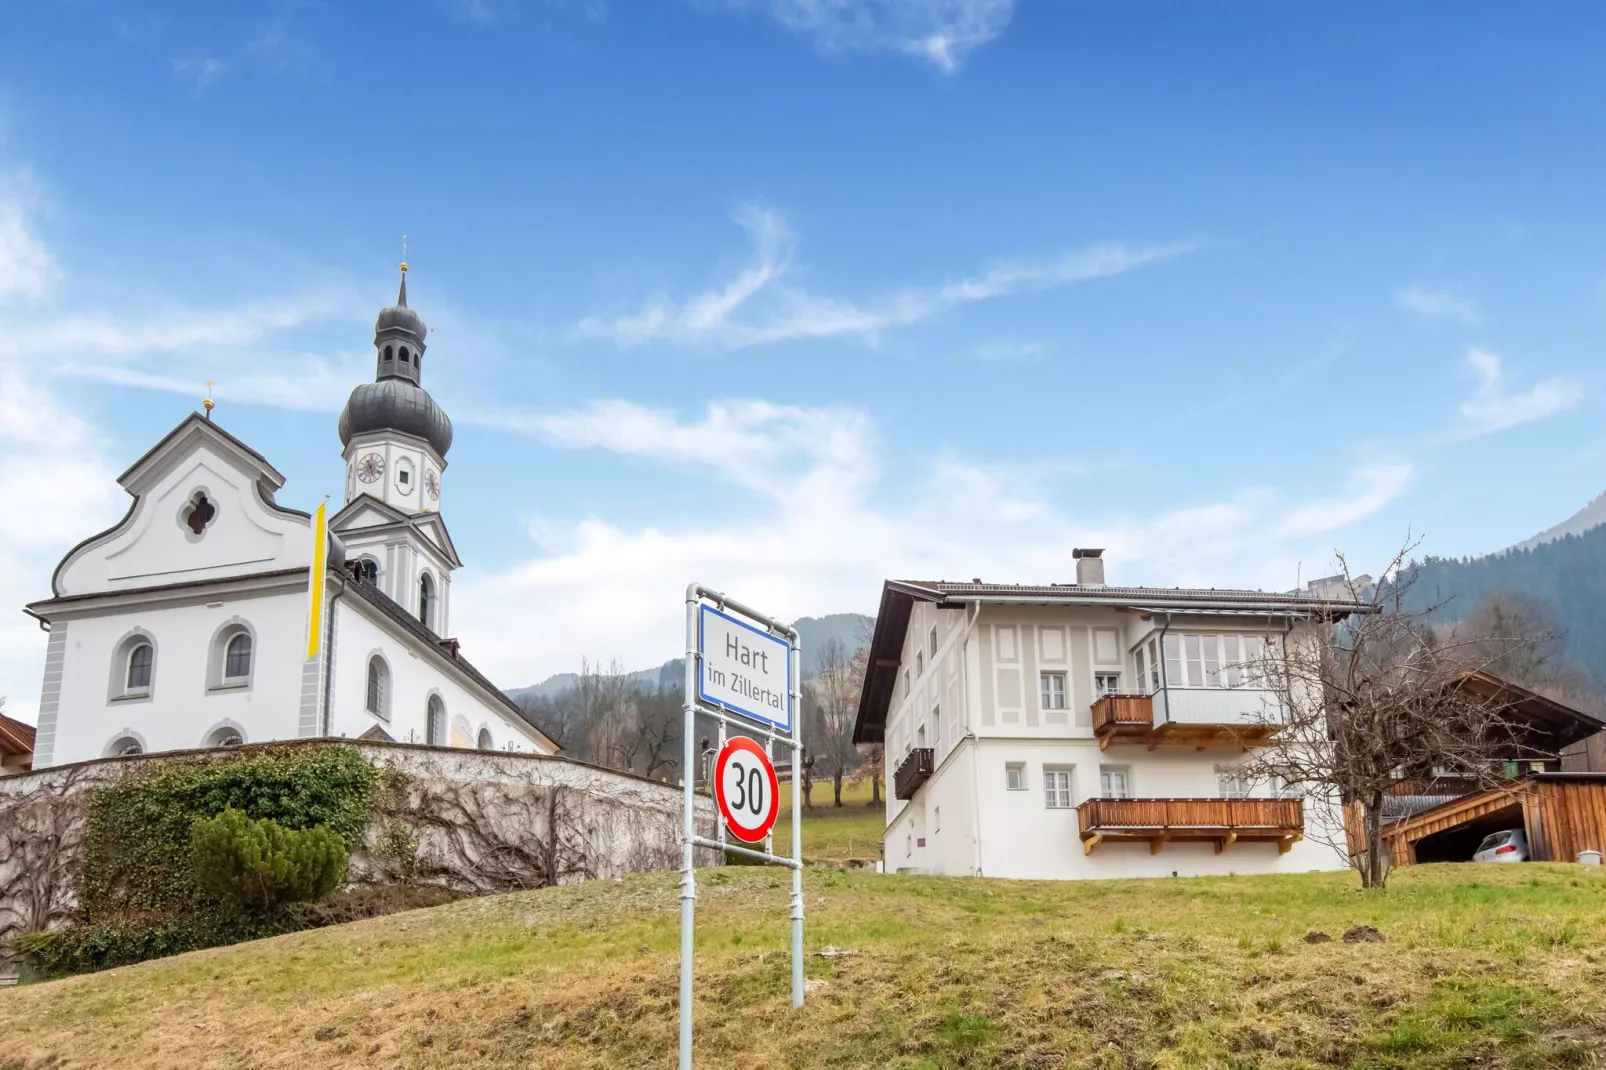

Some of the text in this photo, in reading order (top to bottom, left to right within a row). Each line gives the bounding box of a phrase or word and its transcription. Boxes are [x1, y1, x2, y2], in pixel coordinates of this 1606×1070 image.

[726, 632, 768, 674] Hart
[708, 662, 784, 711] im Zillertal
[731, 762, 763, 815] 30
